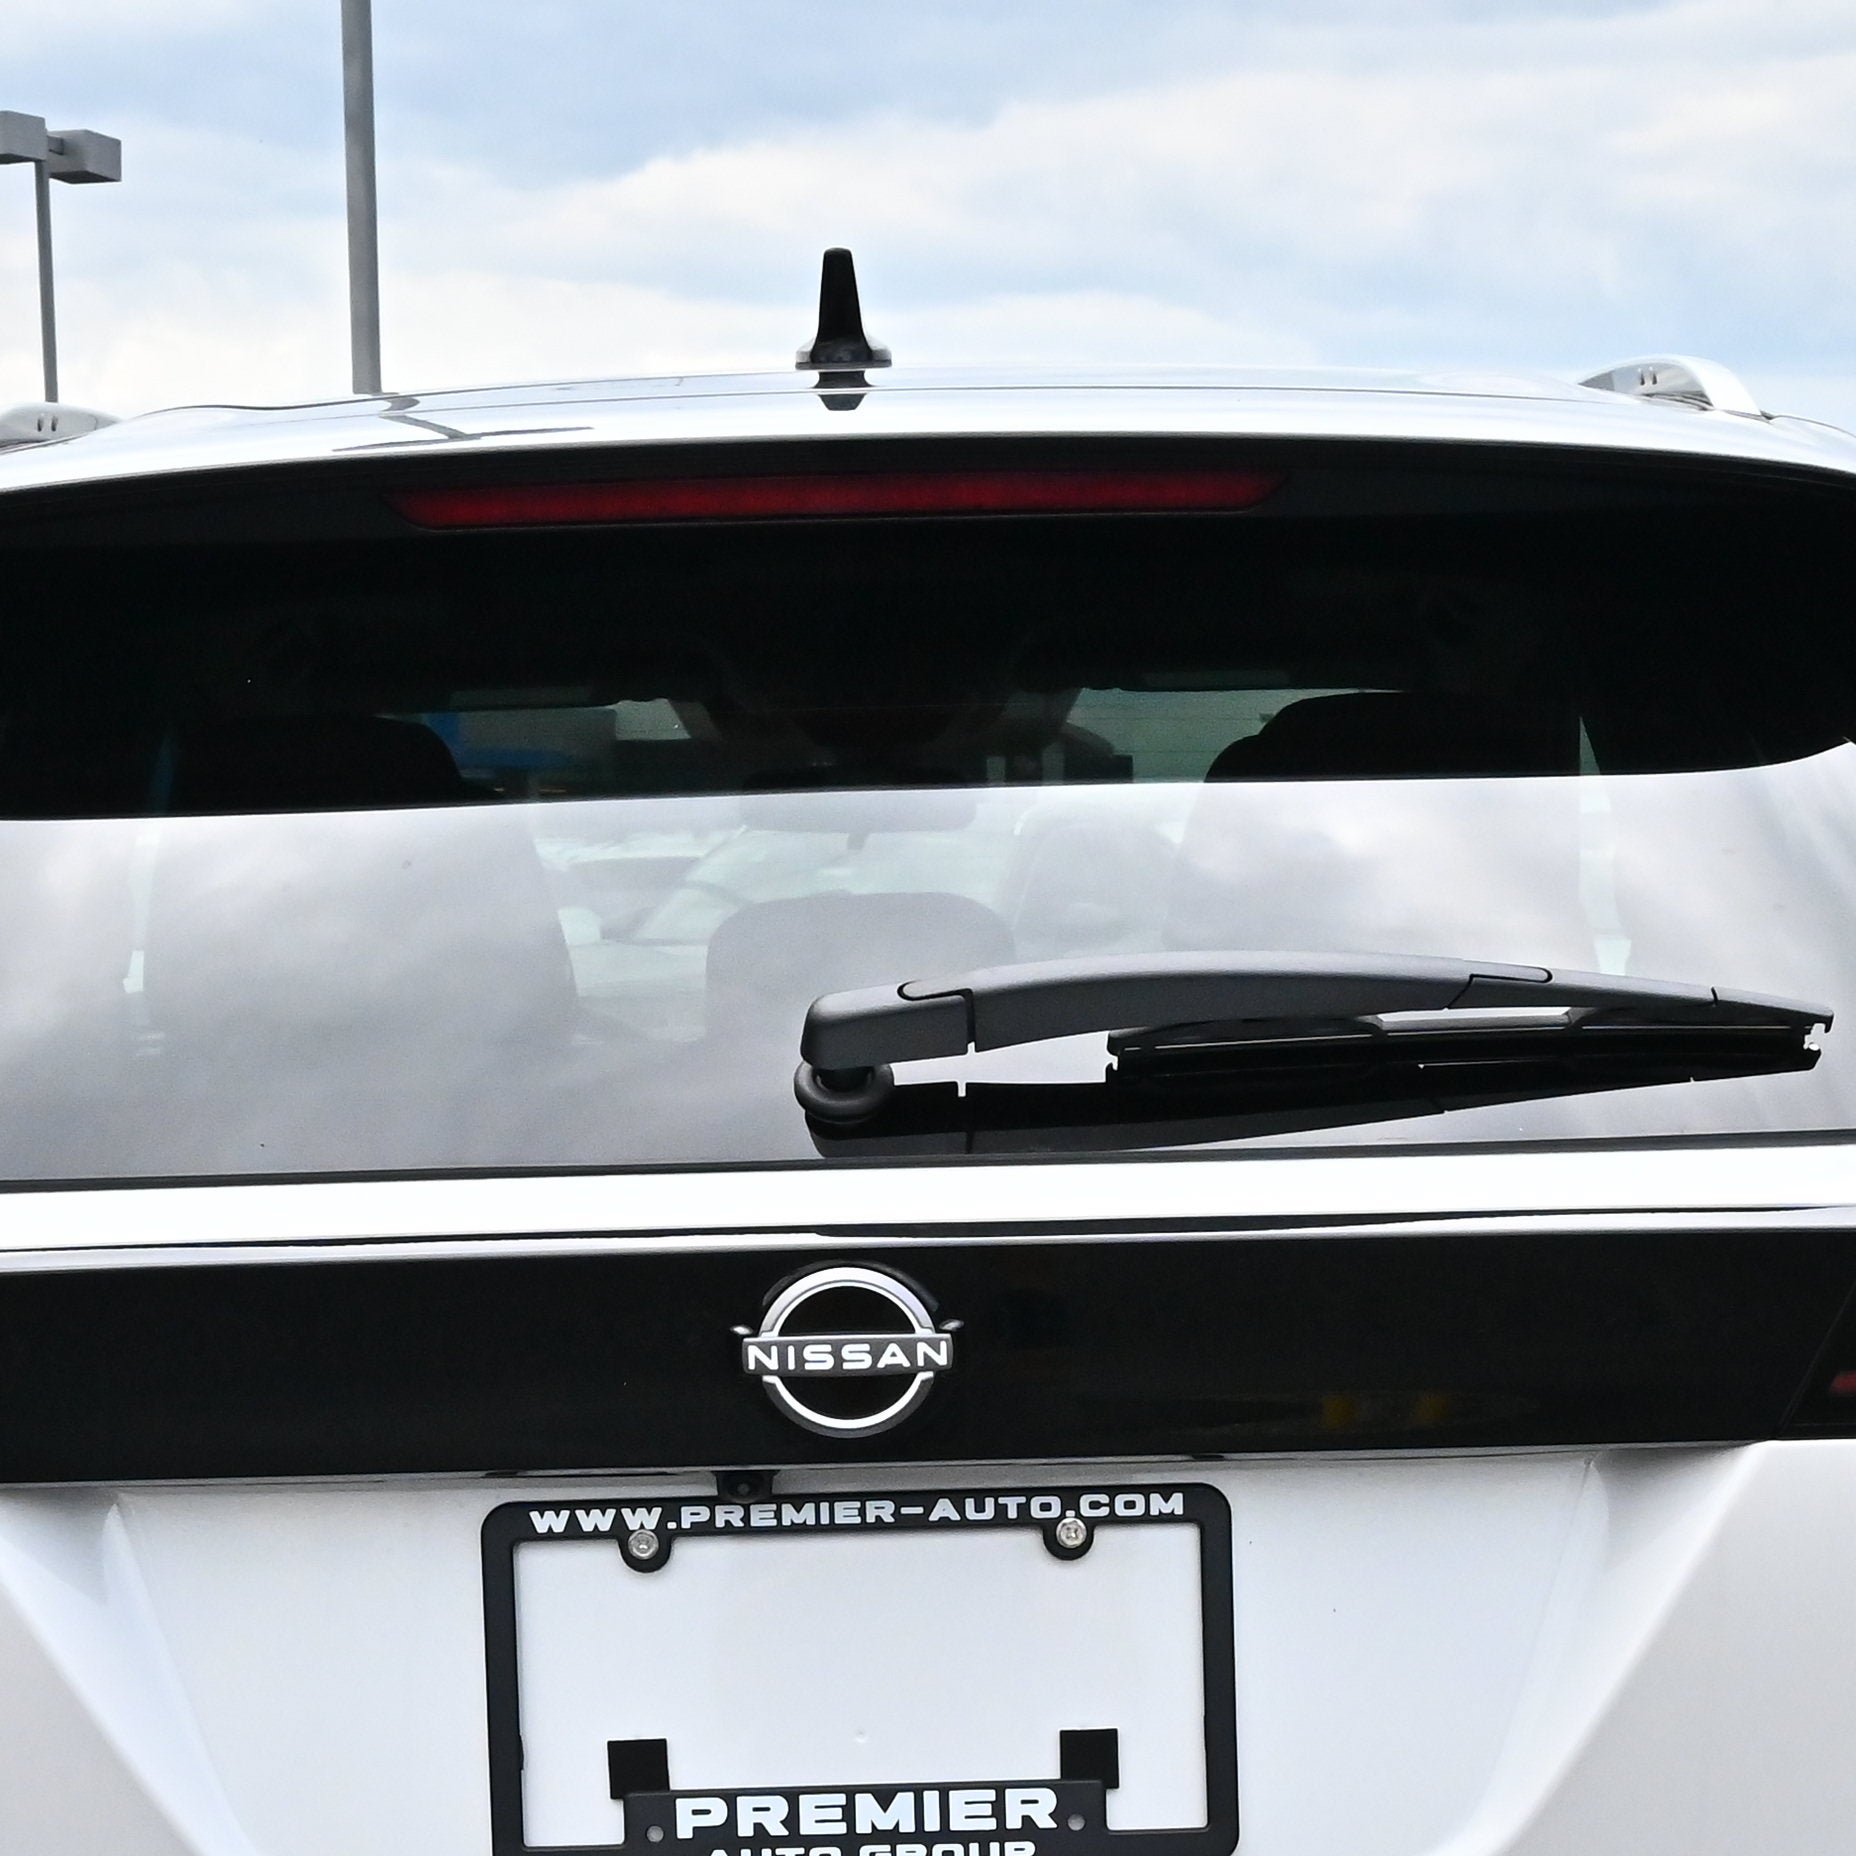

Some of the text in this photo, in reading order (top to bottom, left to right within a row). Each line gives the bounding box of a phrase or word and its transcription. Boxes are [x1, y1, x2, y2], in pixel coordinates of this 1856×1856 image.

[747, 1341, 948, 1371] NISSAN
[528, 1492, 1184, 1534] WWW.PREMIER-AUTO.COM
[675, 1787, 1058, 1840] PREMIER
